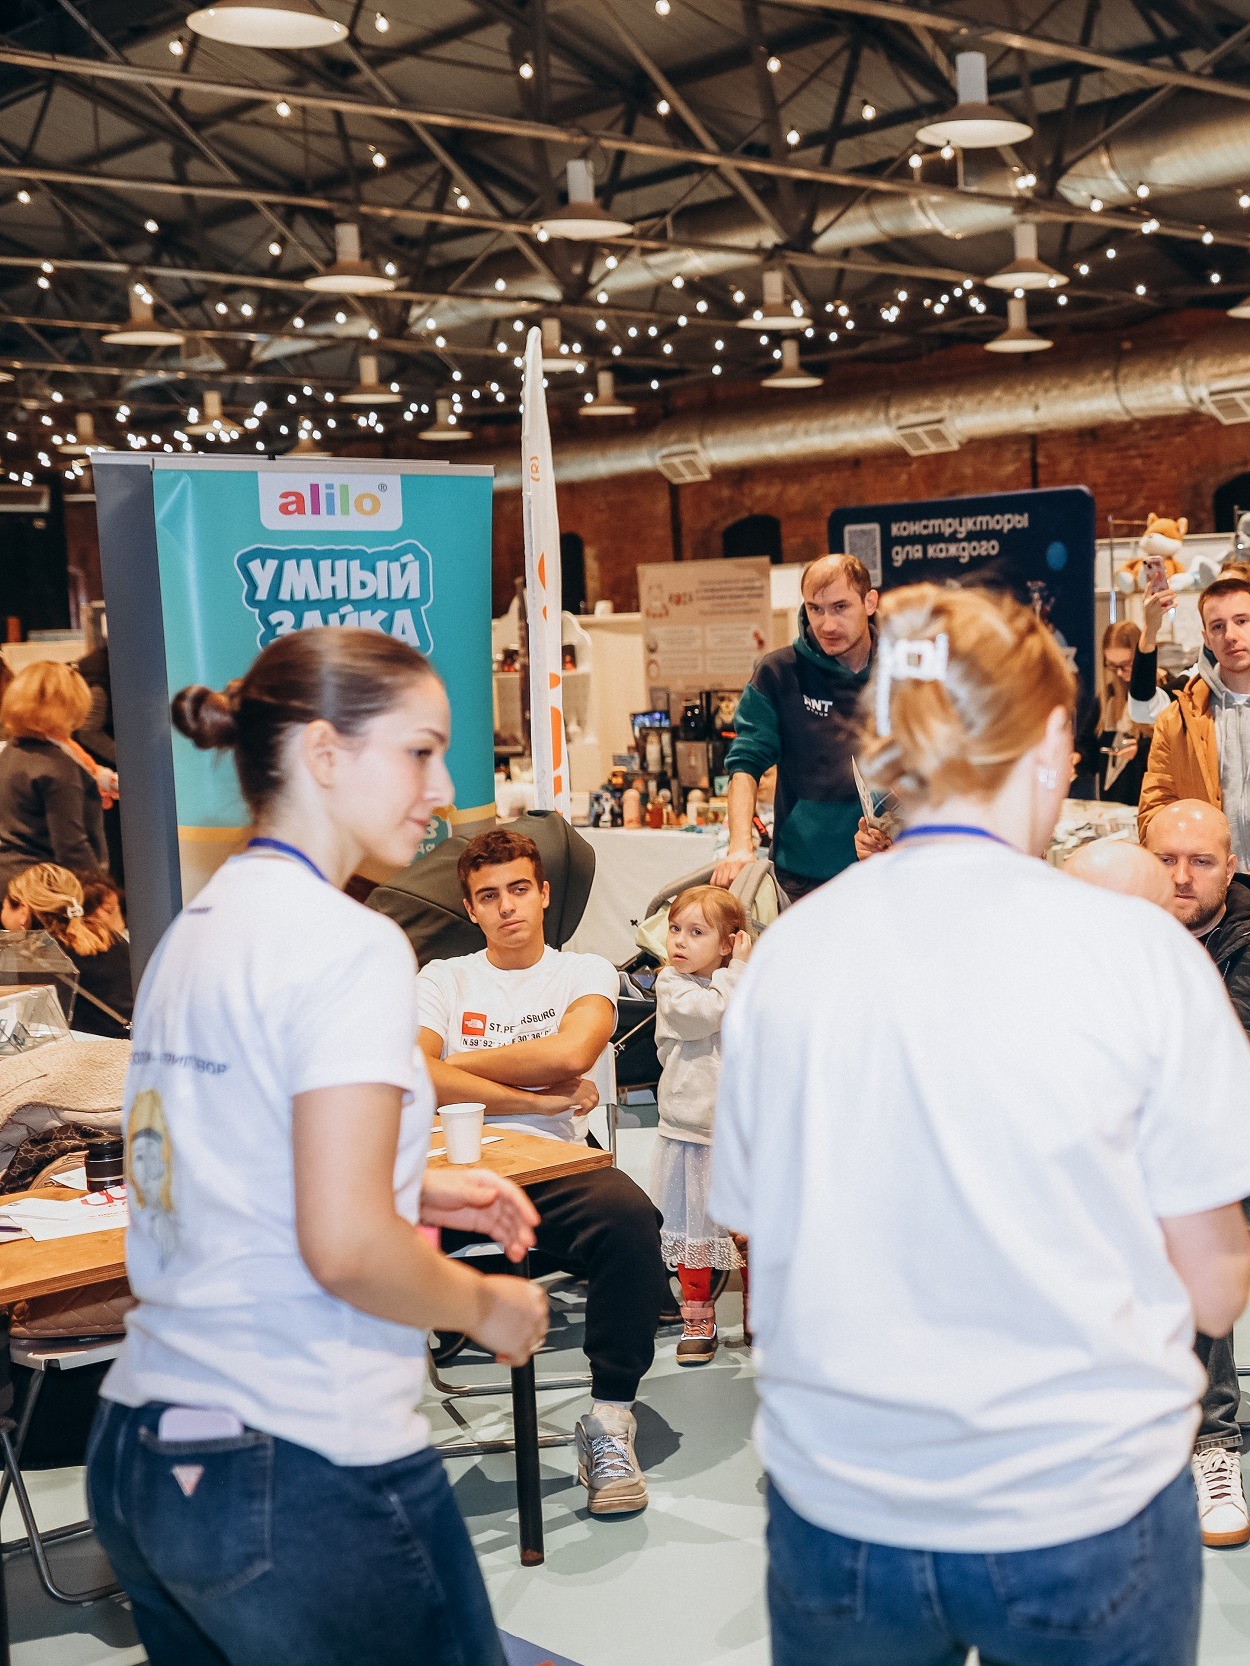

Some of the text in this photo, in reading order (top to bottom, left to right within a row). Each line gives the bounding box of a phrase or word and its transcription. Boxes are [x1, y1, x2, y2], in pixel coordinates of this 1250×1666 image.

[278, 483, 382, 516] alilo
[890, 512, 1029, 539] конструкторы
[891, 539, 1000, 567] для каждого
[246, 553, 421, 602] УМНЫЙ
